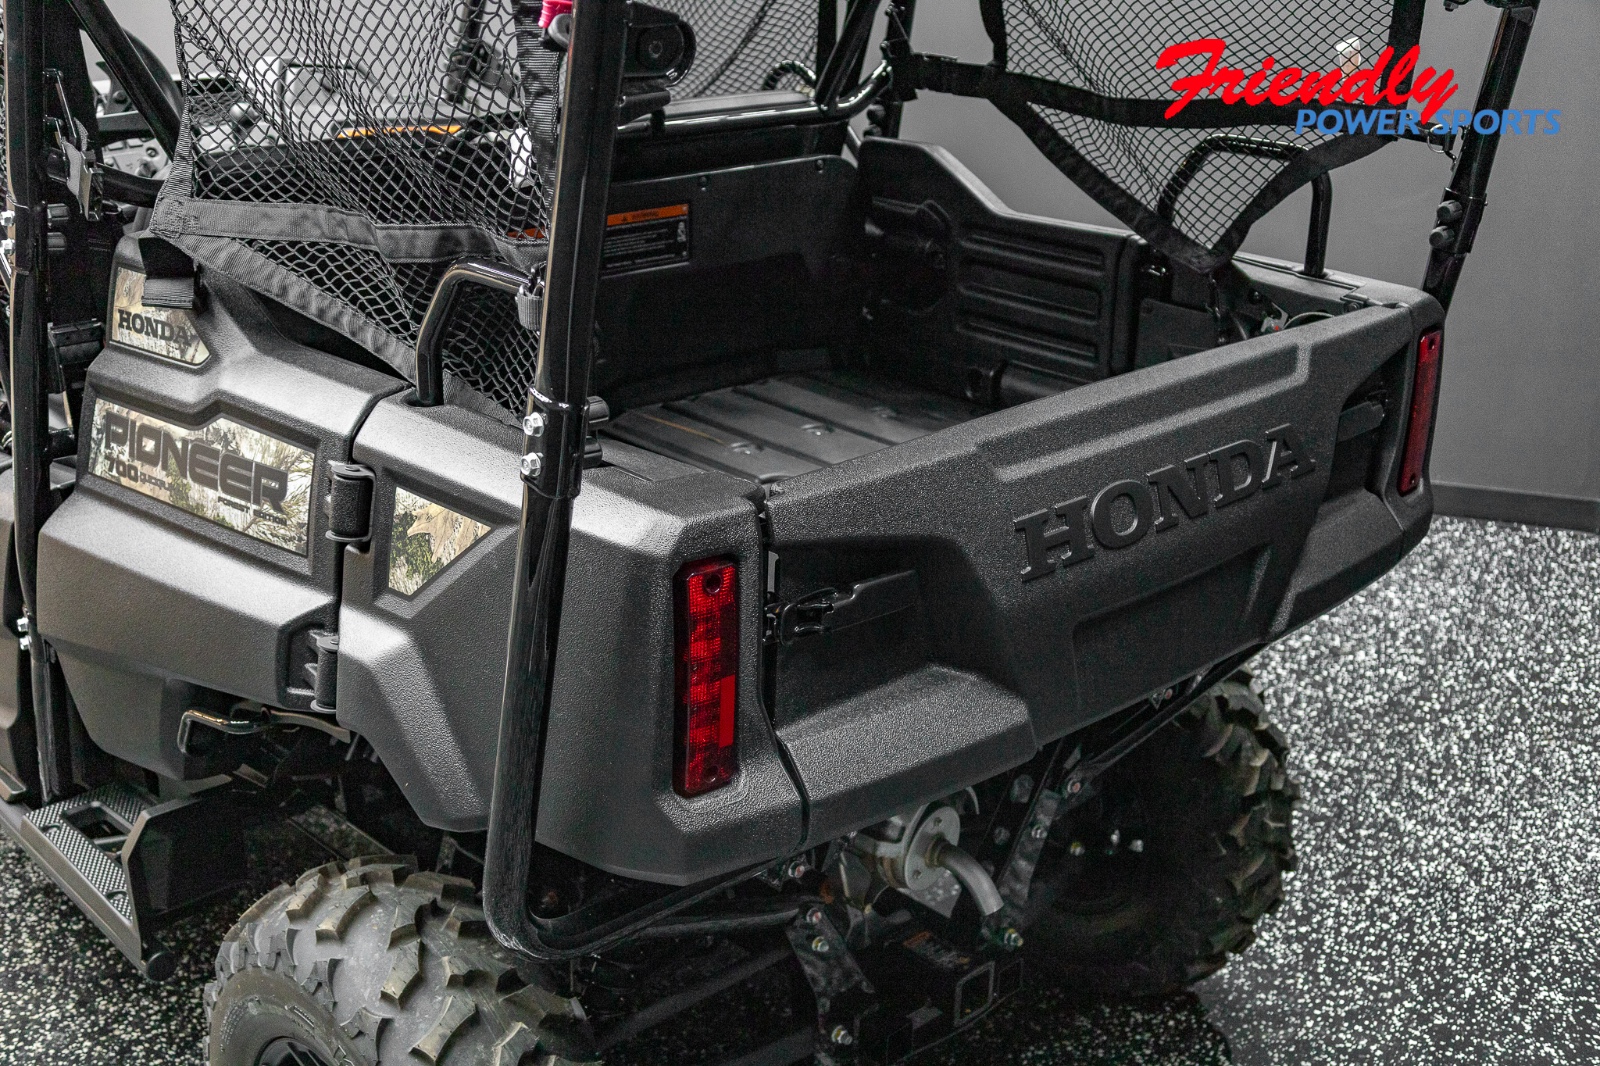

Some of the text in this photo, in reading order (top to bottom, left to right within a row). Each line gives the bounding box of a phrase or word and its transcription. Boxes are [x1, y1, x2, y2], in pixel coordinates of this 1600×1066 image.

[117, 309, 192, 347] HONDA
[104, 454, 139, 483] 700
[105, 411, 289, 516] PIONEER
[1013, 423, 1316, 582] HONDA
